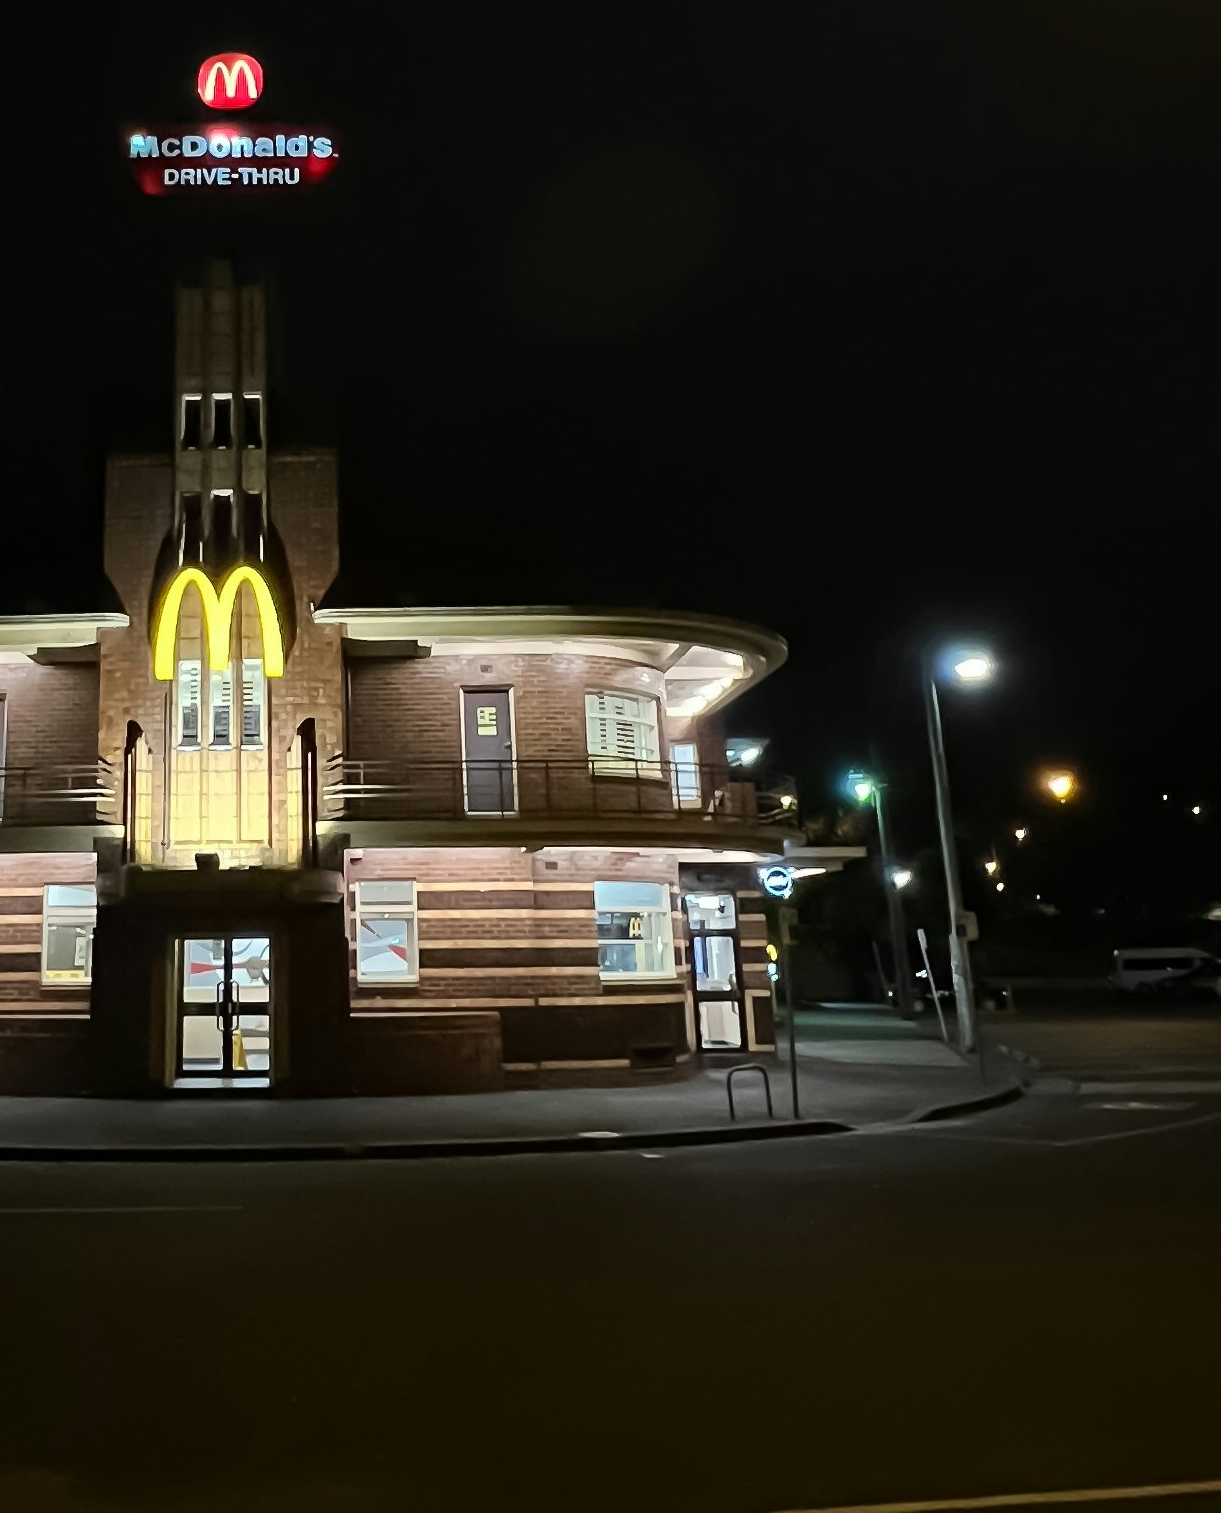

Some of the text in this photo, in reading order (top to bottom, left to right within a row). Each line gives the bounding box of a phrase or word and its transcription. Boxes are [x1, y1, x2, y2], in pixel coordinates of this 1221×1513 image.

[129, 134, 334, 158] McDonald's
[164, 167, 300, 185] DRIVE-THRU
[154, 566, 285, 680] M
